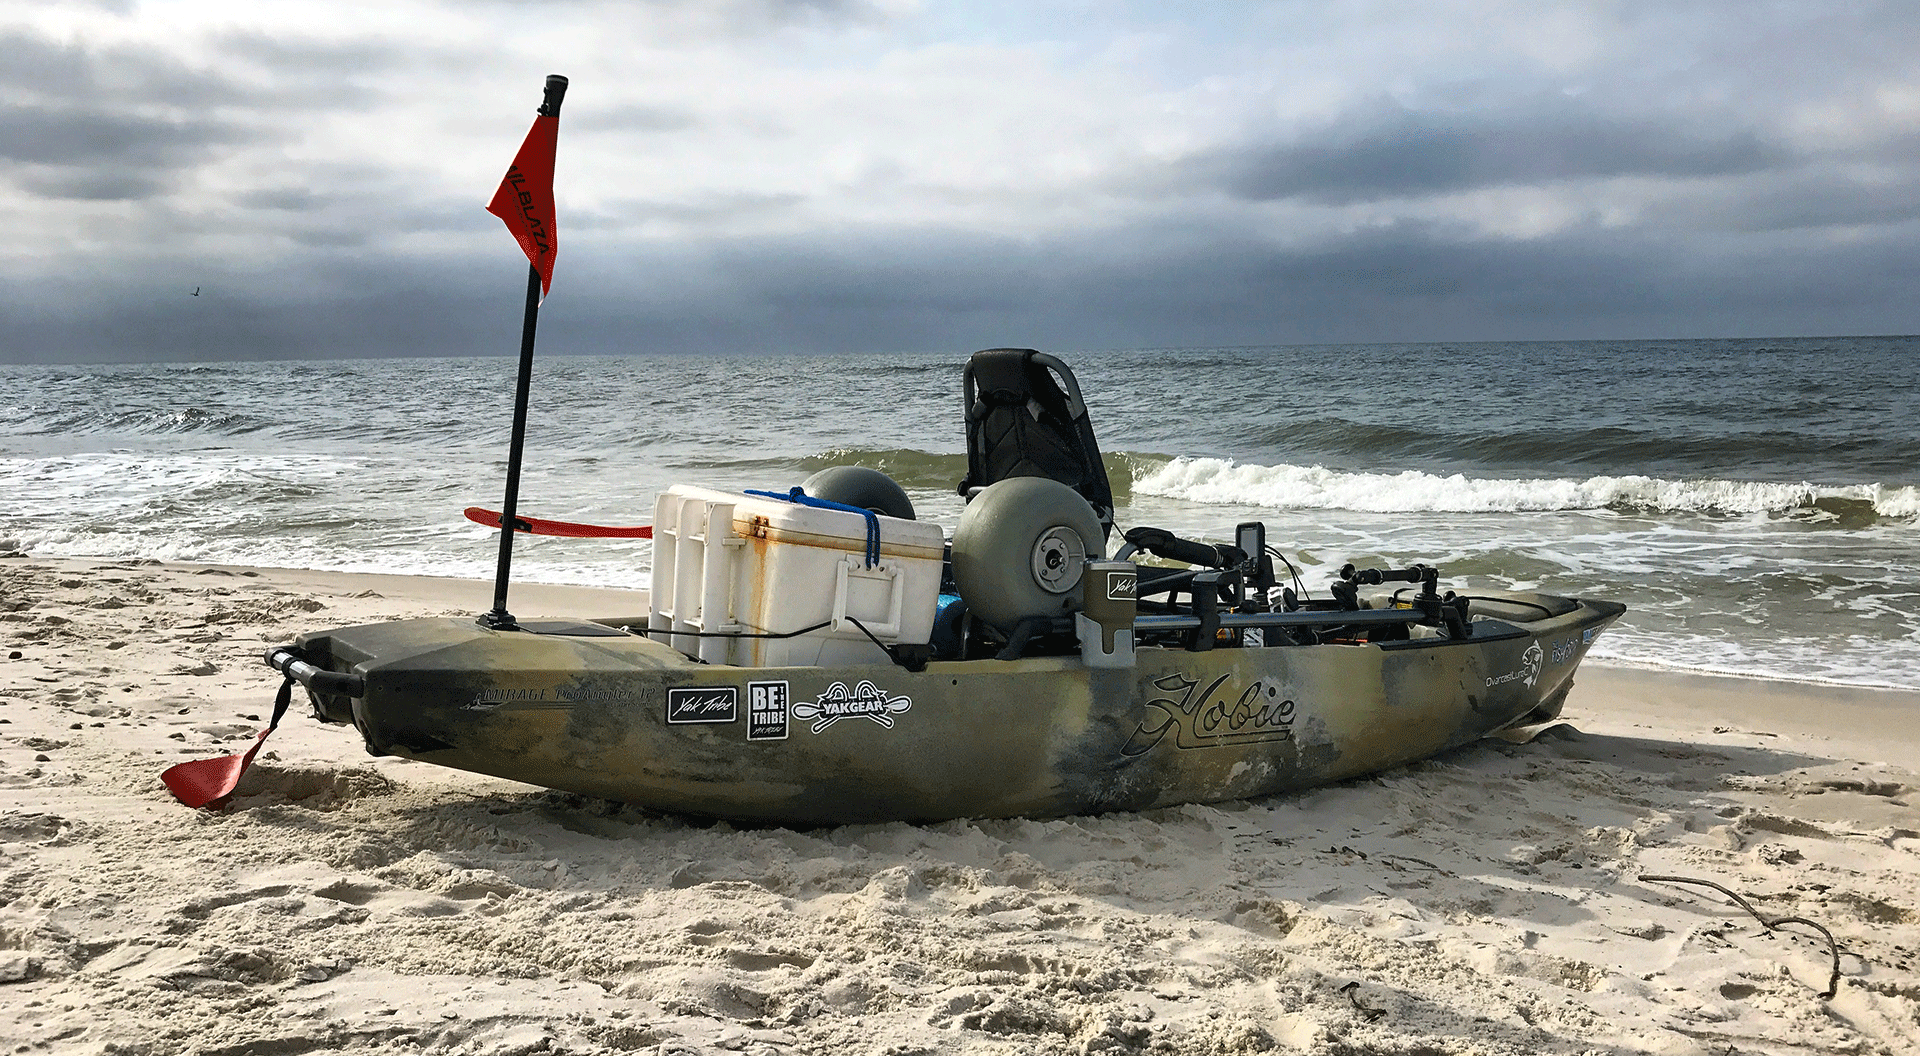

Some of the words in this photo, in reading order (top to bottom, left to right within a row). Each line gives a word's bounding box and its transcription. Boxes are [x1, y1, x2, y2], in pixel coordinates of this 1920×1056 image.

[1110, 579, 1131, 594] Yak
[483, 688, 545, 700] MIRAGE
[752, 686, 779, 711] BE
[672, 697, 703, 717] Yak
[700, 695, 733, 715] Tribe
[822, 700, 885, 715] YAKGEAR
[752, 711, 785, 725] TRIBE
[1120, 671, 1297, 758] Hobie
